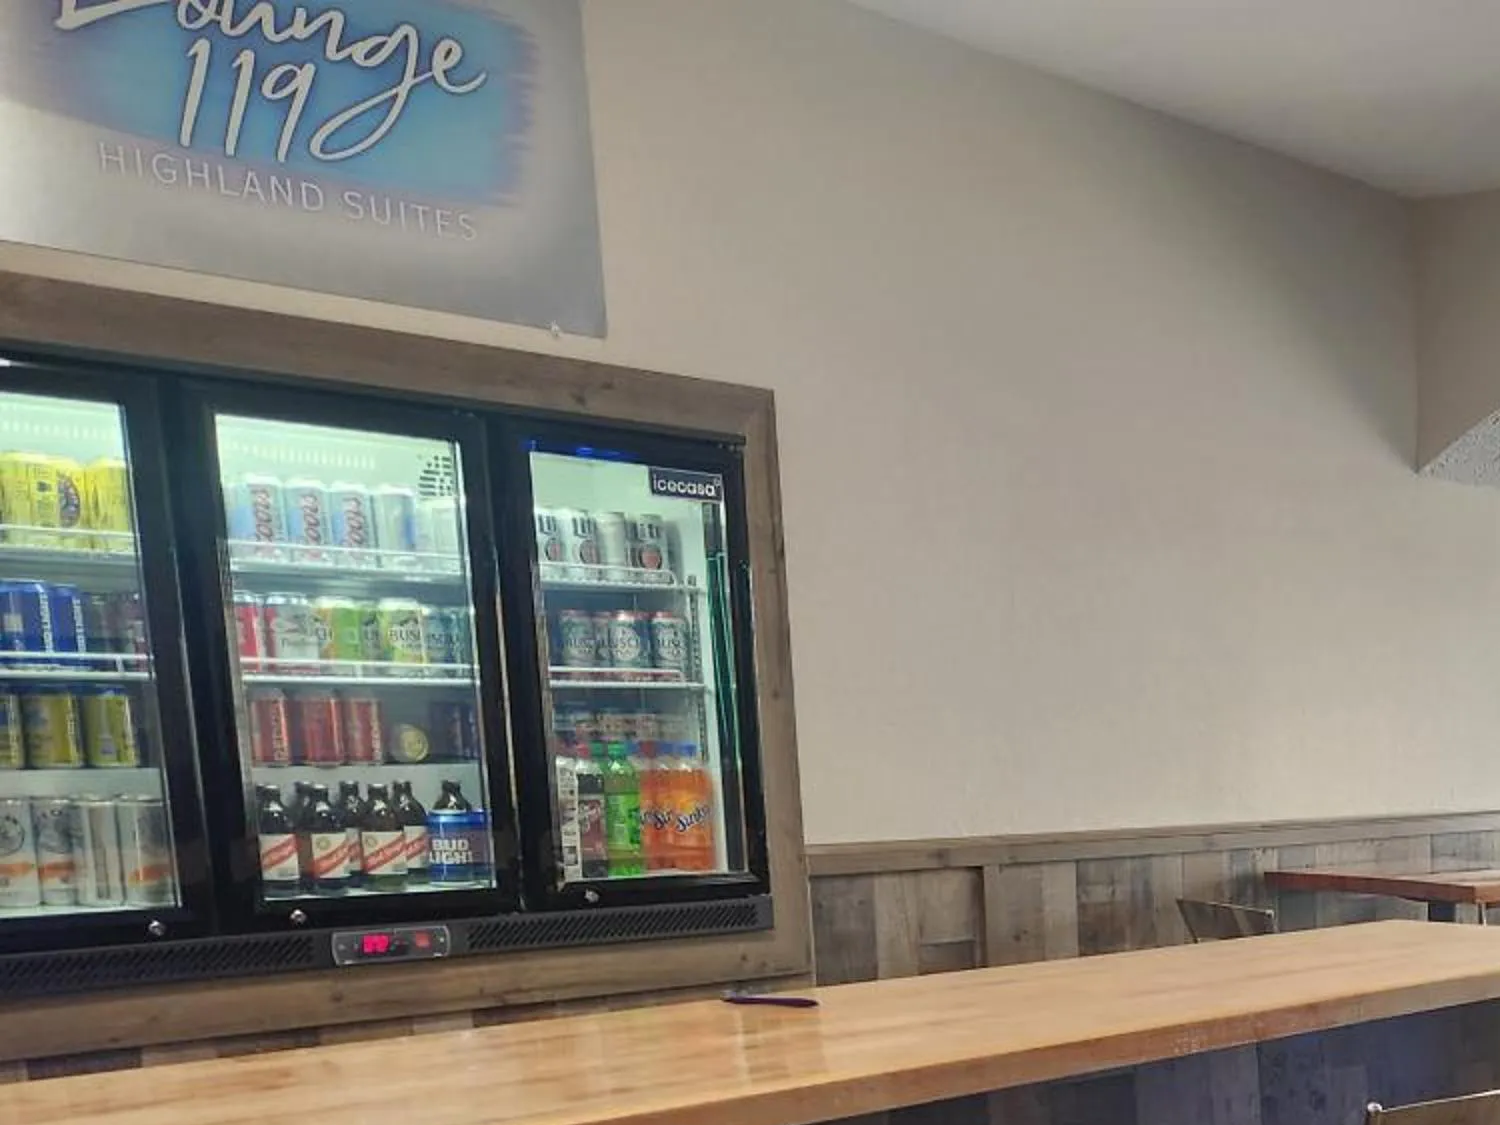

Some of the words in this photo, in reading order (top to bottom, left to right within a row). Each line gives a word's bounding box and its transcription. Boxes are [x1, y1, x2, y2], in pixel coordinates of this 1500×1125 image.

[178, 38, 316, 164] 119
[98, 141, 325, 213] HIGHLAND
[343, 190, 480, 241] SUITES
[428, 851, 474, 866] LIGHT
[431, 838, 469, 851] BUD
